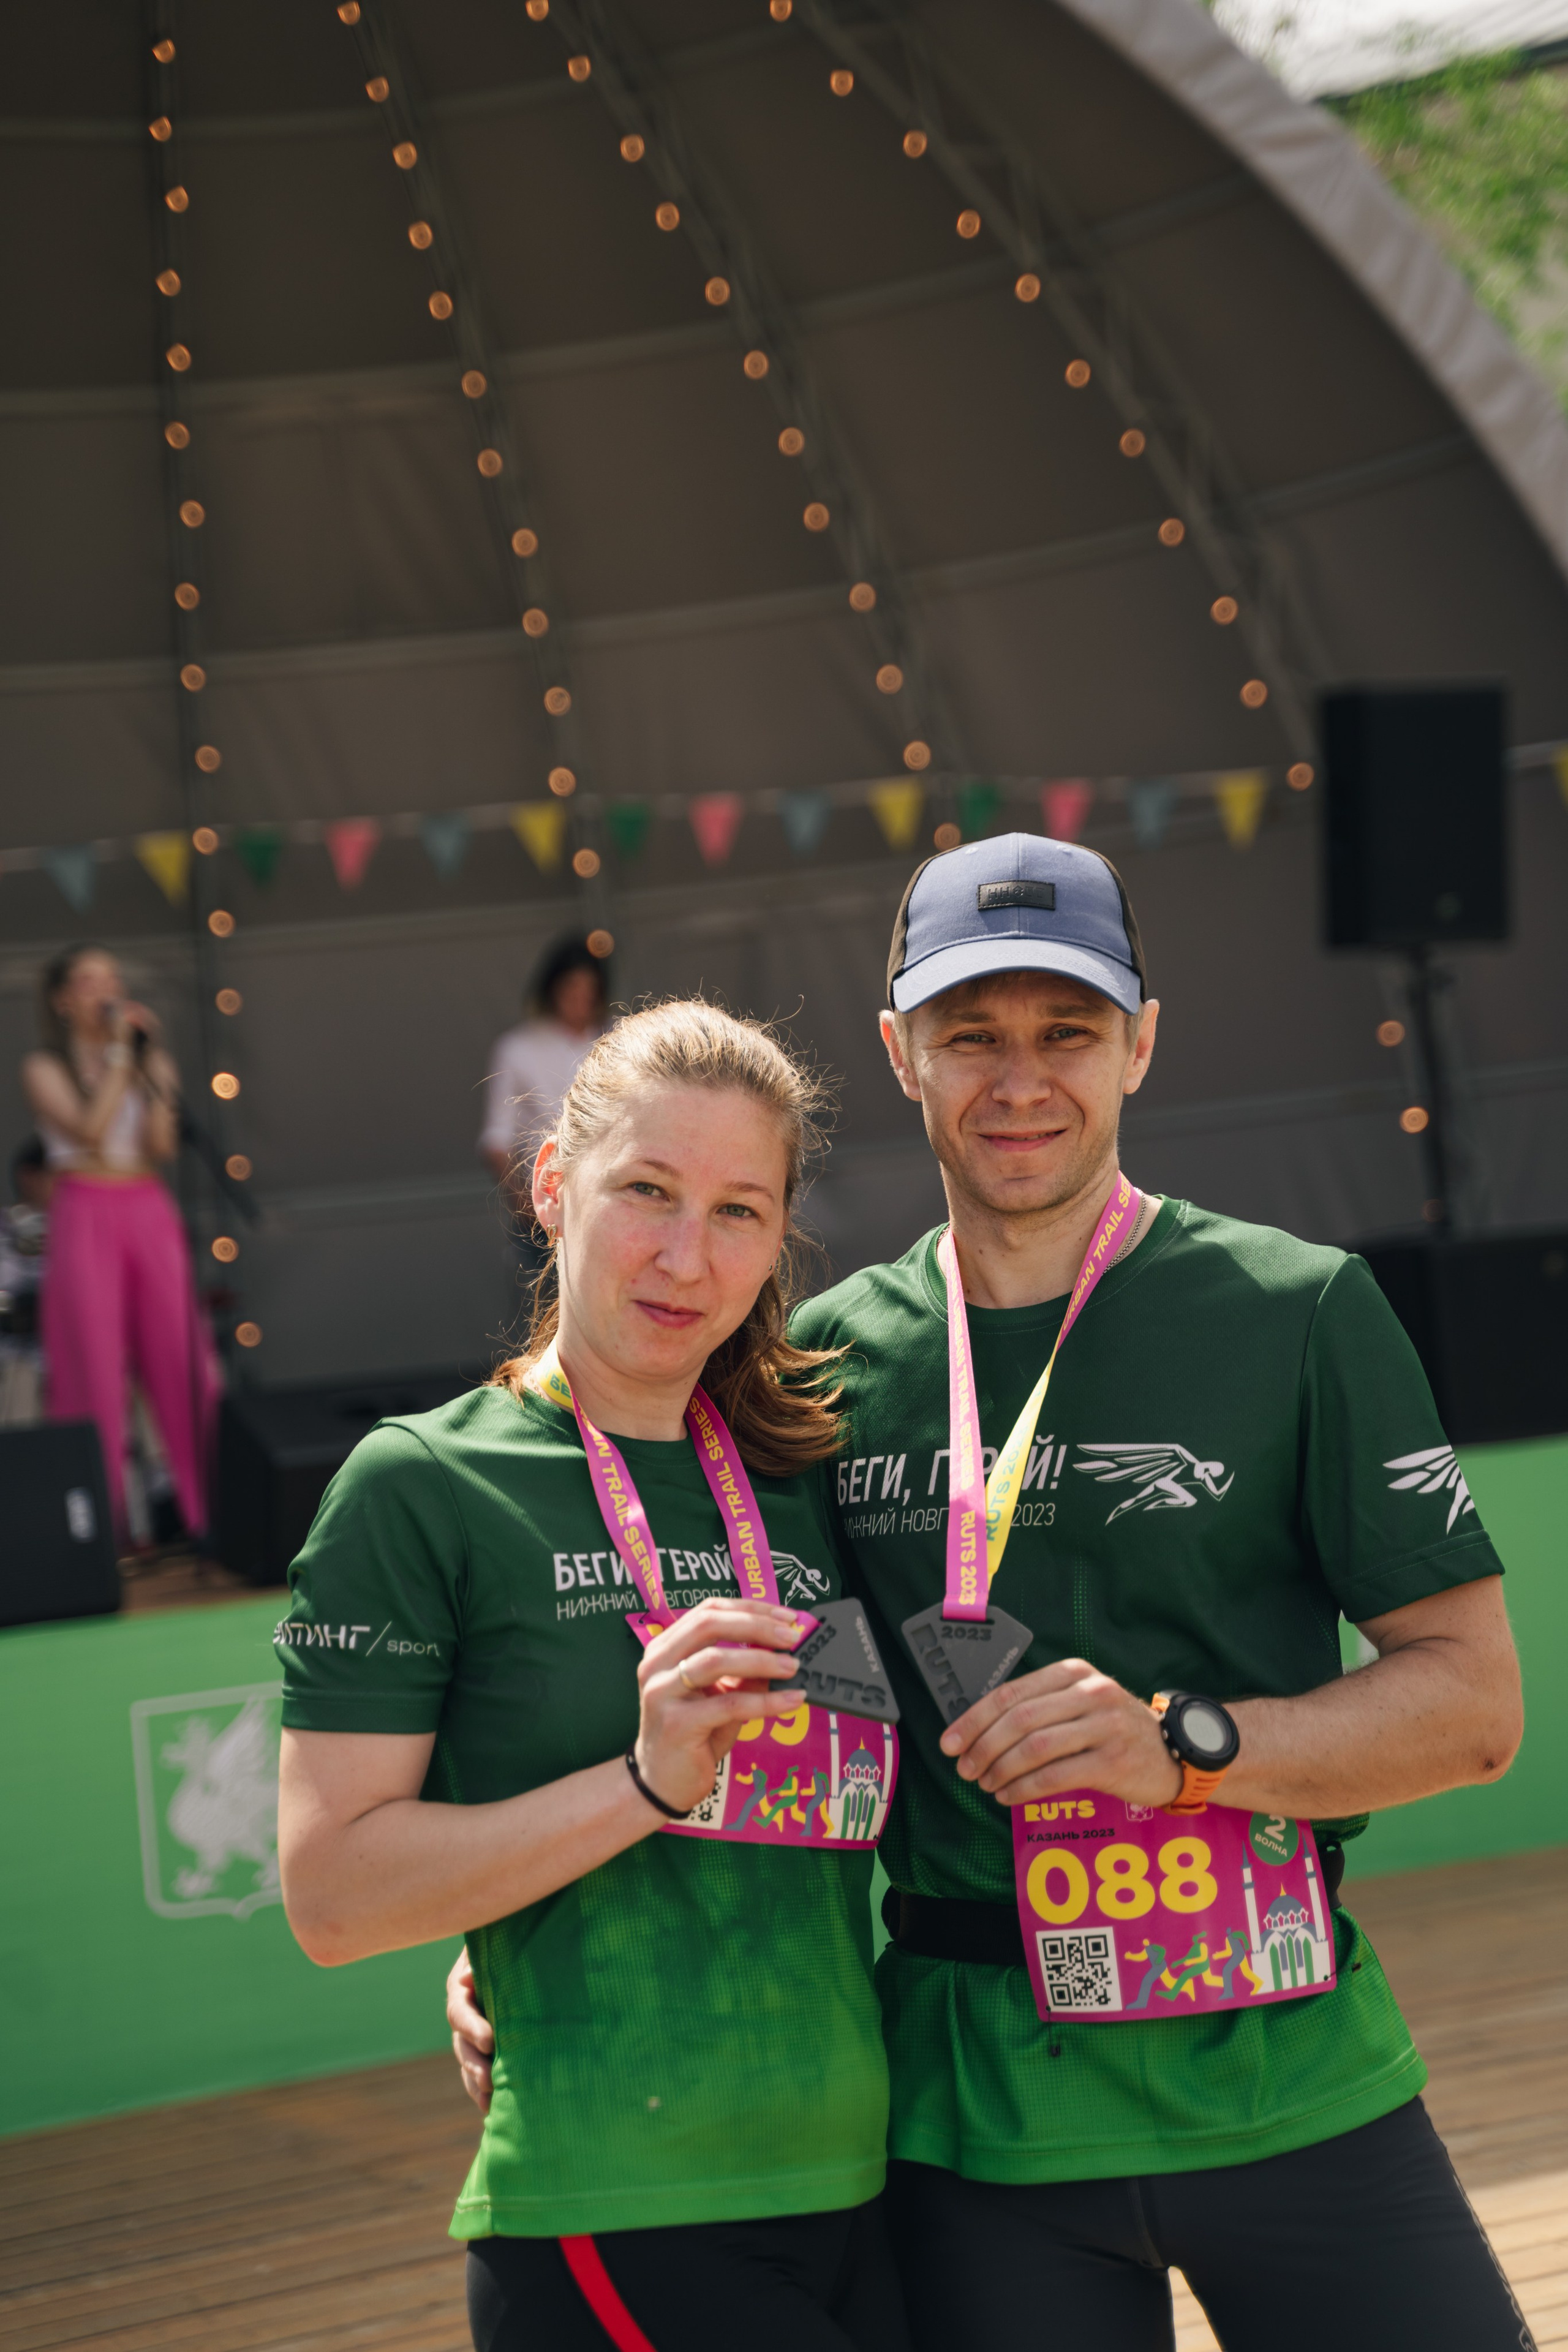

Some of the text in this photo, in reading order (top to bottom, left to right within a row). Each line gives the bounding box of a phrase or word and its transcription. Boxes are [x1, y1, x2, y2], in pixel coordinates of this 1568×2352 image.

[1063, 1260, 1096, 1331] URBAN
[1093, 1210, 1125, 1262] TRAIL
[957, 1363, 971, 1425] TRAIL
[837, 1453, 911, 1506] БЕГИ,
[959, 1422, 975, 1491] SERIES
[689, 1396, 766, 1599] URBAN TRAIL SERIES
[986, 1480, 1011, 1541] RUTS
[1011, 1503, 1056, 1526] 2023
[602, 1461, 633, 1527] TRAIL
[624, 1525, 660, 1610] SERIES
[960, 1509, 976, 1563] RUTS
[556, 1590, 639, 1621] НИЖНИЙ
[799, 1624, 837, 1667] 2023
[856, 1616, 880, 1673] КАЗАНЬ
[941, 1626, 992, 1642] 2023
[1024, 1800, 1096, 1822] RUTS
[1027, 1828, 1116, 1843] КАЗАНЬ 2023
[1264, 1814, 1286, 1842] 2
[1255, 1832, 1287, 1857] ВОЛНА
[1027, 1836, 1218, 1924] 088
